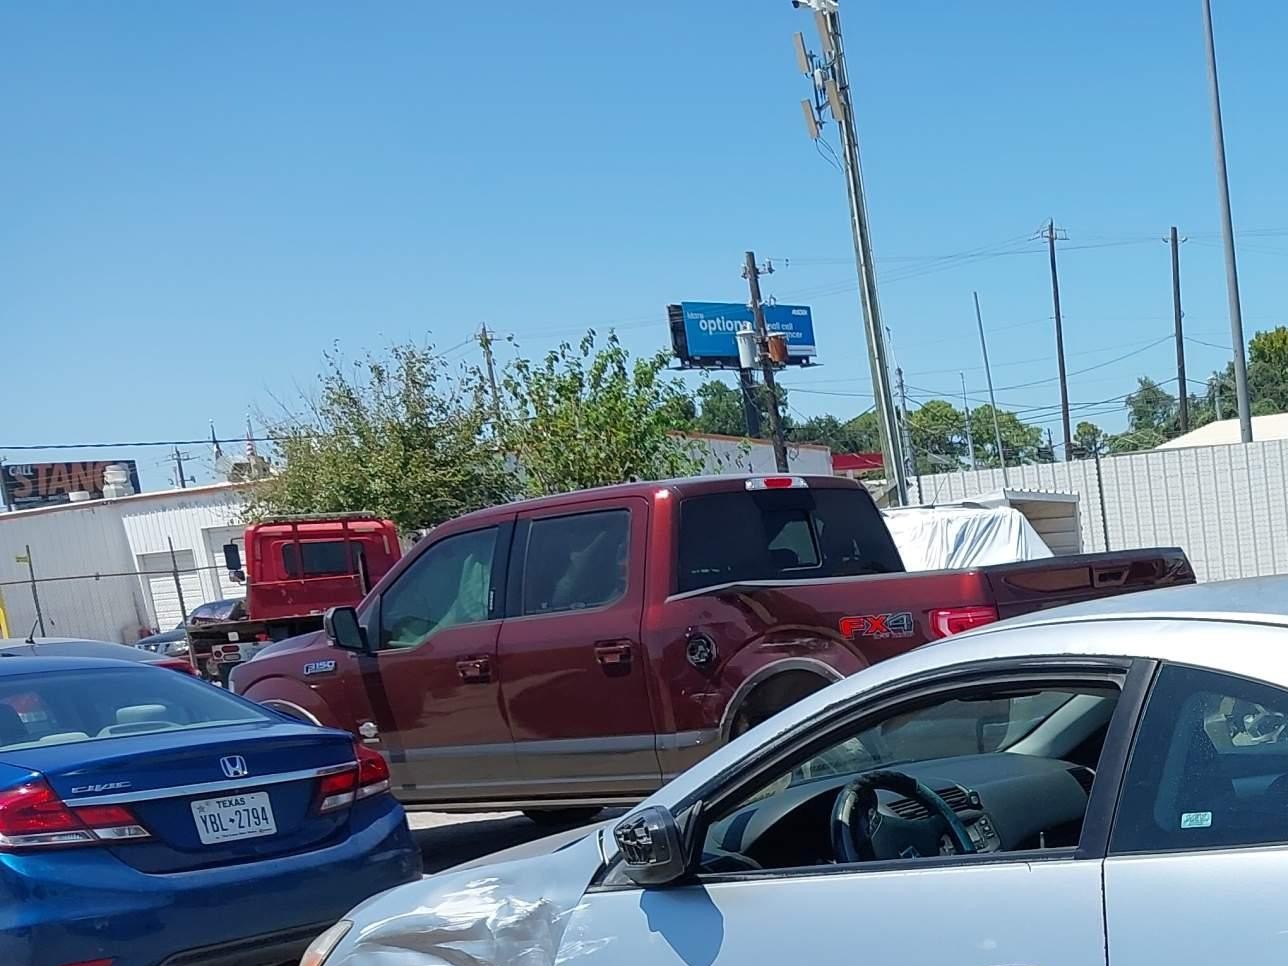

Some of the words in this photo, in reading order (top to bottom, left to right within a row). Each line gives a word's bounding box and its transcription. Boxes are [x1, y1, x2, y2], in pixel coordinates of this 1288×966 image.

[699, 316, 749, 335] option
[8, 464, 34, 477] CALL
[839, 612, 914, 640] FX4
[71, 781, 132, 794] CIVIC
[215, 797, 246, 809] TEXAS
